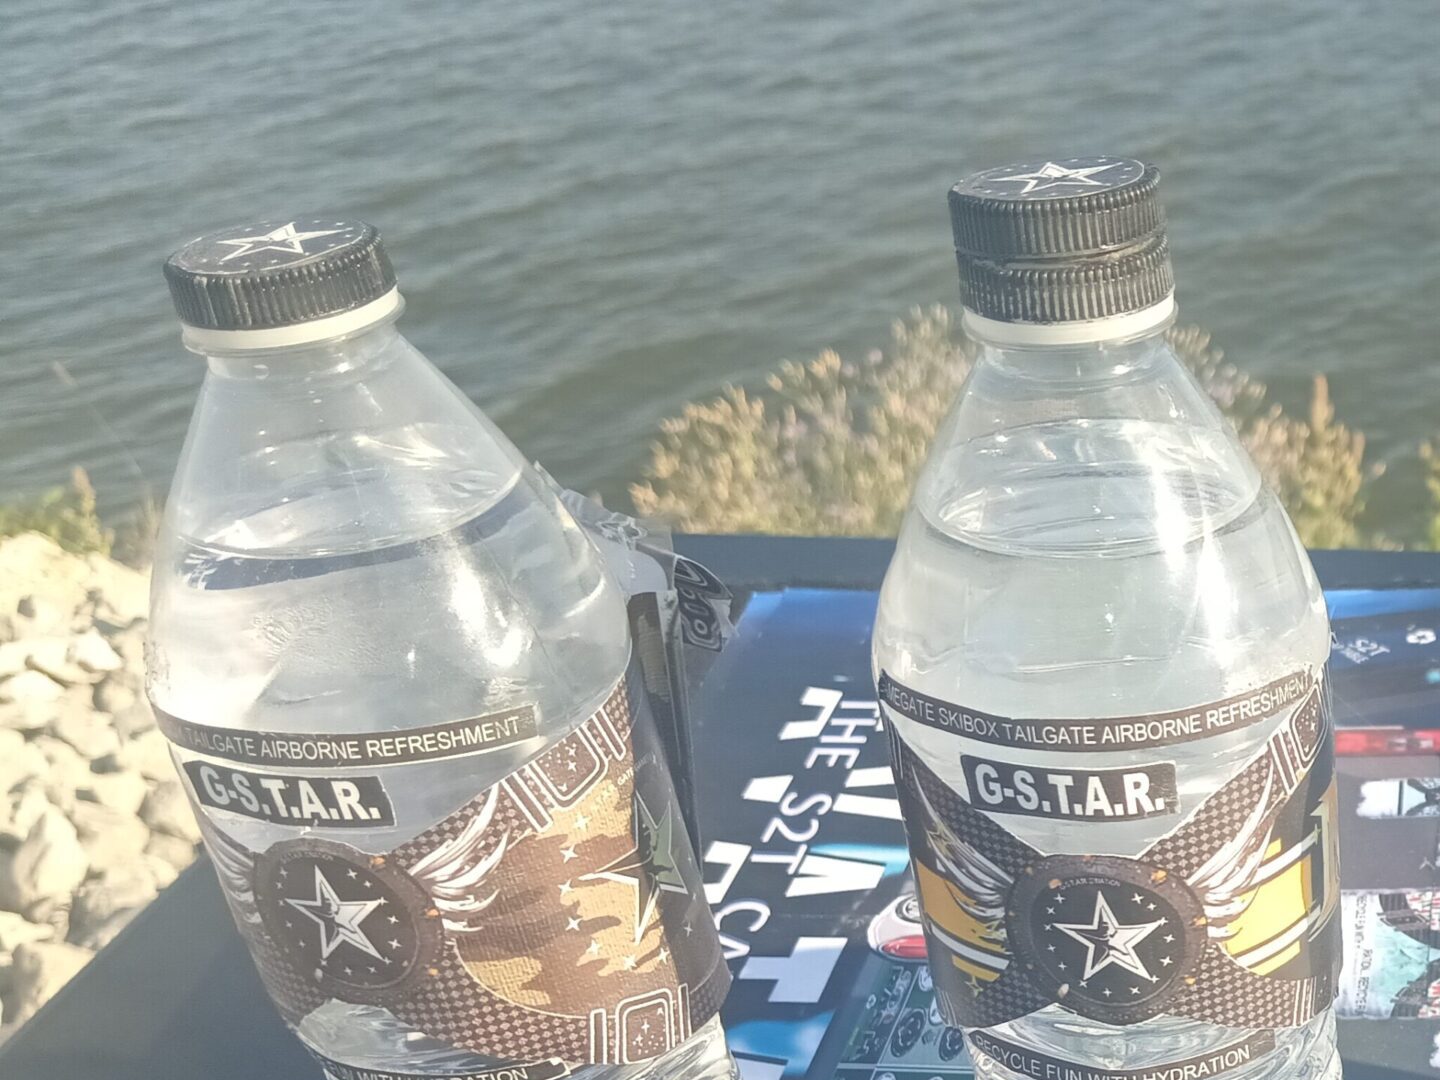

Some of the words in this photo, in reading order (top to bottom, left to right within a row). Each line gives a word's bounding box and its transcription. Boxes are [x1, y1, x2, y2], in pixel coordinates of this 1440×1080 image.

[804, 700, 881, 769] THE
[938, 707, 1000, 738] SKIBOX
[1002, 723, 1096, 745] TAILGATE
[1101, 714, 1202, 744] AIRBORNE
[1205, 673, 1310, 729] REFRESHMENT
[261, 741, 361, 761] AIRBORNE
[366, 716, 520, 757] REFRESHMENT
[199, 765, 382, 820] G-S.T.A.R.
[975, 763, 1165, 816] G-S.T.A.R.
[750, 792, 832, 876] S2T
[975, 1036, 1041, 1077] RECYCLE
